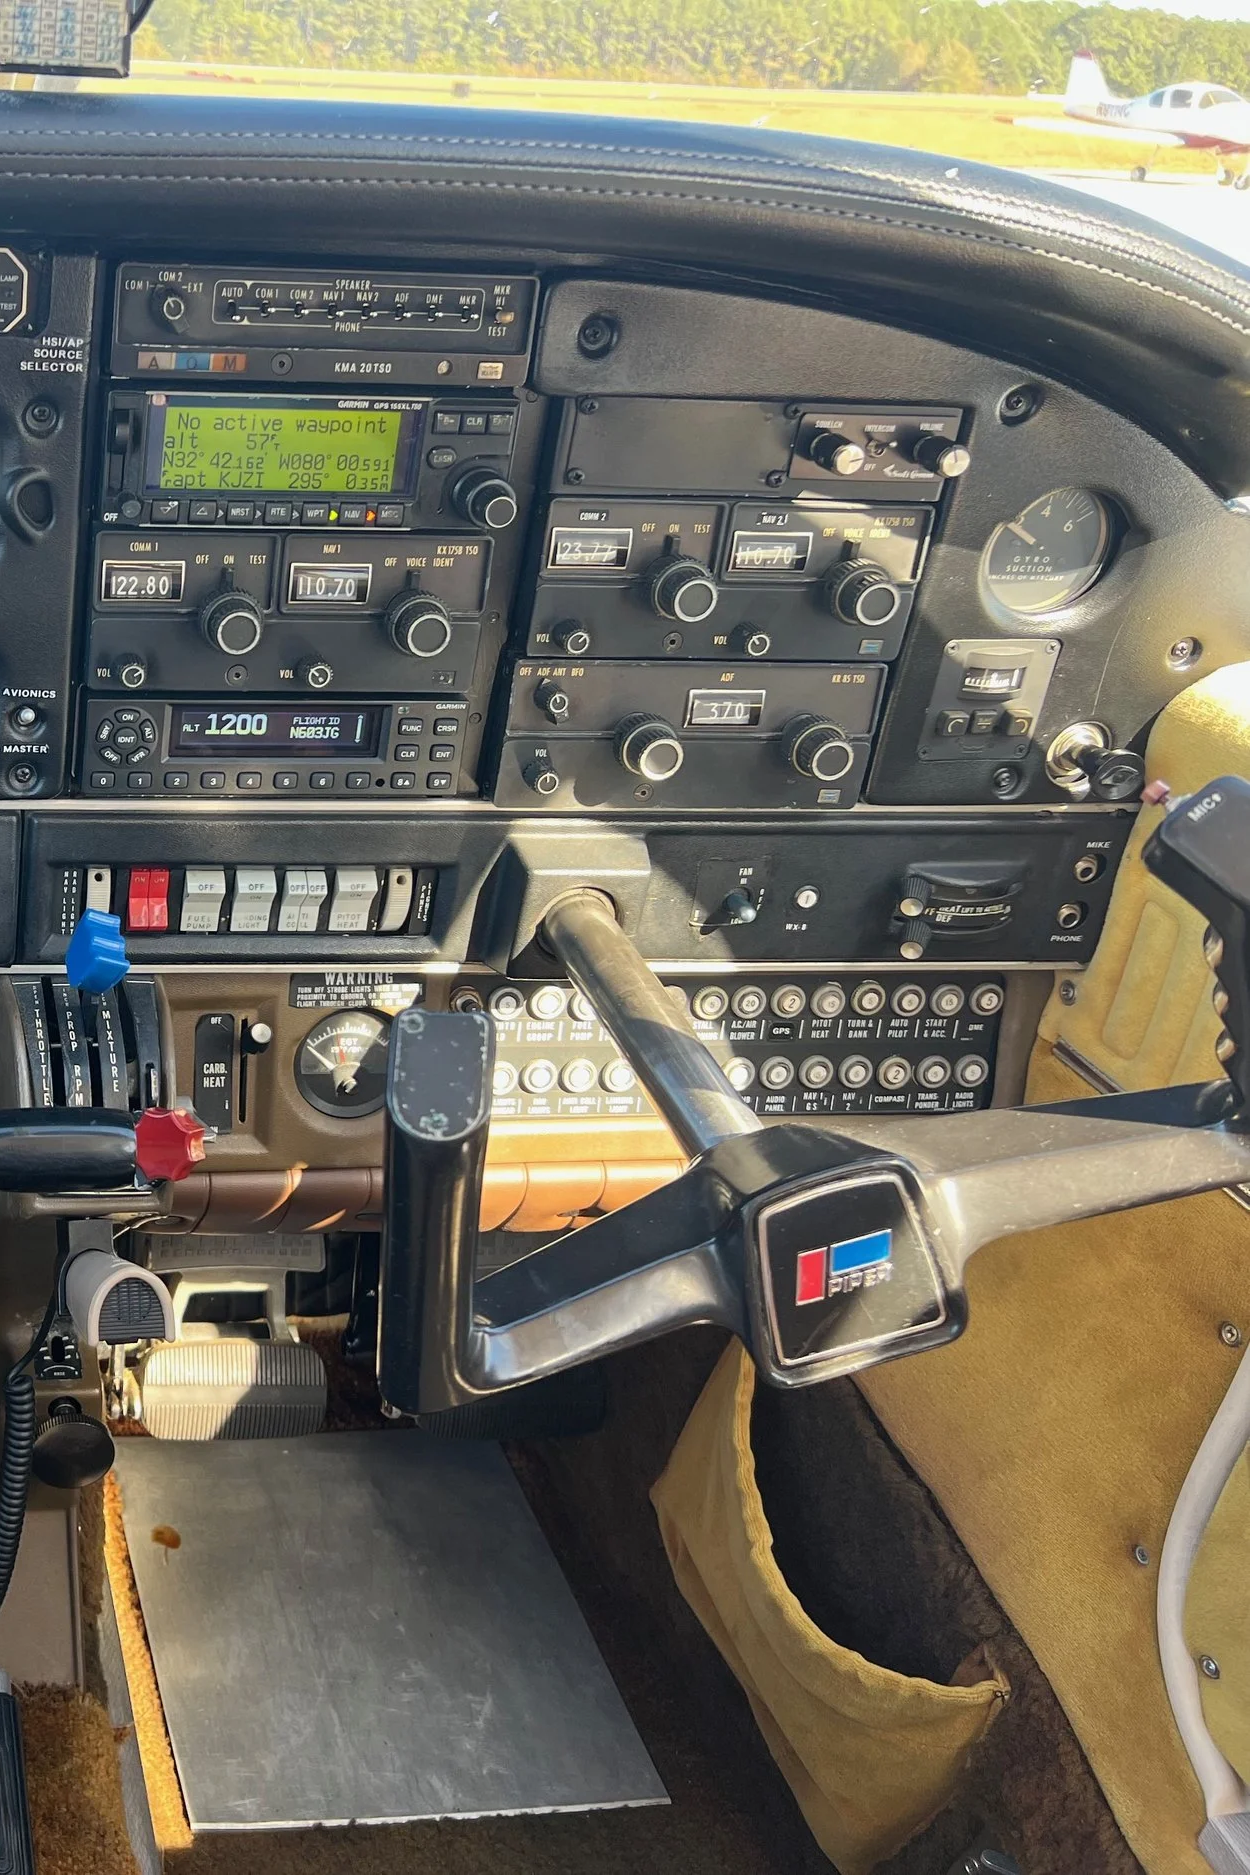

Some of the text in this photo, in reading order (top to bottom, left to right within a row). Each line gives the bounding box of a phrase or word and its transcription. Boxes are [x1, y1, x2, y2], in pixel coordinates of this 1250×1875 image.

[335, 279, 370, 290] SPEAKER
[222, 287, 243, 298] AUTO
[494, 285, 510, 295] MKR
[394, 292, 409, 302] ADF
[426, 294, 443, 304] DME
[459, 295, 476, 305] MKR
[334, 322, 360, 332] PHONE
[488, 326, 506, 337] TEST
[43, 337, 84, 347] HSI/AP
[34, 349, 83, 359] SOURCE
[20, 362, 83, 372] SELECTOR
[178, 413, 386, 434] No active waypoint
[165, 434, 198, 449] alt
[219, 471, 262, 487] KJZI
[642, 523, 710, 534] OFF ON TEST
[196, 555, 266, 564] OFF ON TEST
[385, 558, 454, 567] OFF VOICE IDENT
[111, 575, 169, 595] 122.80
[299, 578, 355, 597] 110.70
[536, 634, 549, 643] VOL
[714, 635, 727, 644] VOL
[97, 668, 111, 677] VOL
[280, 670, 293, 678] VOL
[3, 688, 56, 698] AVIONICS
[183, 714, 267, 735] ALT 1200
[290, 727, 339, 739] N603JG
[535, 748, 547, 757] VOL
[1187, 798, 1216, 822] MIC
[1087, 841, 1111, 849] MIKE
[325, 973, 393, 985] WARNING
[812, 1018, 832, 1027] PITOT
[890, 1018, 908, 1027] AUTO
[925, 1018, 947, 1027] START
[772, 1026, 790, 1036] GPS
[811, 1029, 829, 1038] HEAT
[848, 1029, 867, 1038] BANK
[888, 1029, 908, 1038] PILOT
[102, 1010, 119, 1092] MIXTURE
[34, 1009, 50, 1106] THROTTLE
[204, 1064, 228, 1075] CARB.
[204, 1077, 226, 1088] HEAT
[875, 1095, 905, 1103] COMPASS
[828, 1262, 894, 1297] PIPER
